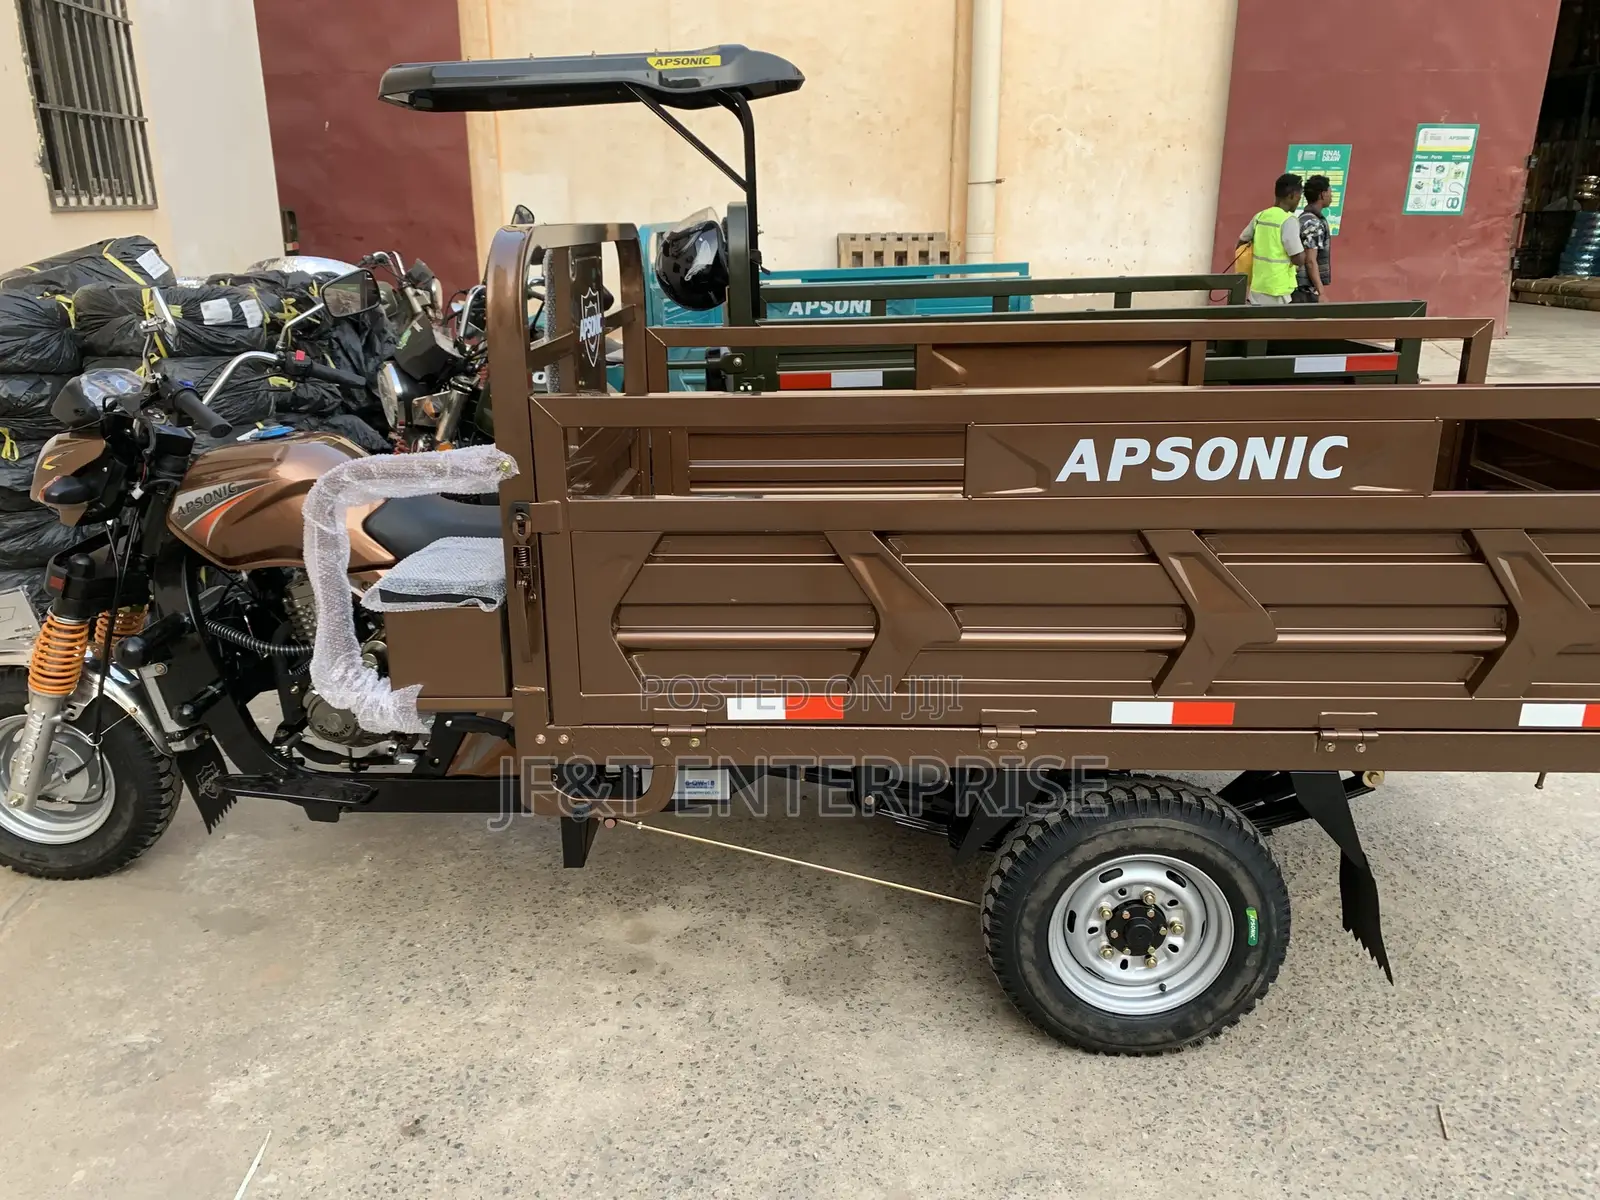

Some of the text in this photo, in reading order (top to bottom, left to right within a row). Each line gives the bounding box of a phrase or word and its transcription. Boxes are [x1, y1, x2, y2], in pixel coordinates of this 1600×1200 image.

[655, 57, 711, 67] APSONIC
[788, 300, 872, 316] APSONI
[1055, 435, 1349, 482] APSONIC
[176, 482, 239, 520] APSONIC
